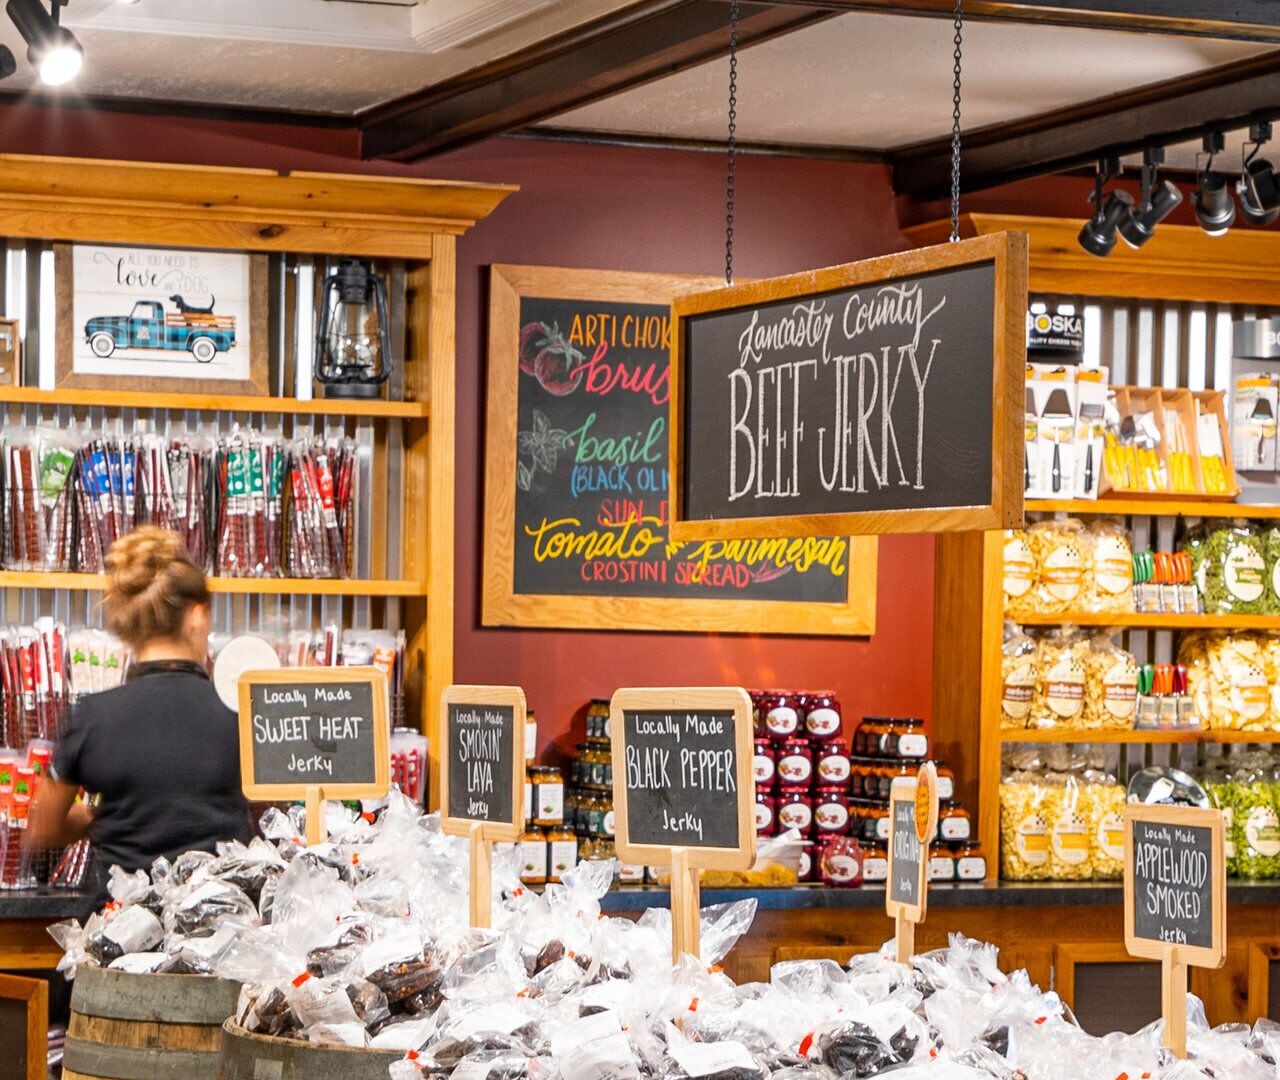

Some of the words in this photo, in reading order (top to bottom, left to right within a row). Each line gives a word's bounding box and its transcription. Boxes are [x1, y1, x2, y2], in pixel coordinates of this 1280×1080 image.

[126, 252, 143, 267] ALL
[146, 253, 163, 268] YOU
[163, 254, 186, 268] NEED
[189, 256, 200, 268] IS
[184, 276, 209, 294] DOG
[738, 299, 834, 368] Lancaster
[842, 282, 947, 351] County
[727, 358, 818, 502] BEEF
[817, 339, 942, 494] JERKY
[562, 412, 667, 467] basil
[597, 498, 644, 526] SUN
[524, 512, 663, 562] tomato
[688, 534, 846, 584] parmesan
[580, 559, 668, 583] CROSTINI
[674, 560, 751, 589] SPREAD
[263, 688, 308, 708] Locally
[314, 687, 352, 702] Made
[253, 714, 311, 744] SWEET
[319, 716, 363, 741] HEAT
[455, 708, 484, 727] Locally
[484, 710, 504, 725] Made
[634, 714, 681, 743] Locally
[684, 714, 725, 736] Made
[458, 728, 502, 763] SMOKIN'
[287, 753, 333, 776] Jerky
[467, 760, 494, 797] LAVA
[625, 744, 672, 791] BLACK
[680, 747, 737, 793] PEPPER
[467, 797, 489, 819] Jerky
[662, 809, 704, 841] Jerky
[1144, 825, 1172, 845] Locally
[1174, 829, 1196, 844] Made
[1135, 841, 1208, 889] APPLEWOOD
[1146, 881, 1201, 920] SMOKED
[1158, 925, 1187, 945] Jerky
